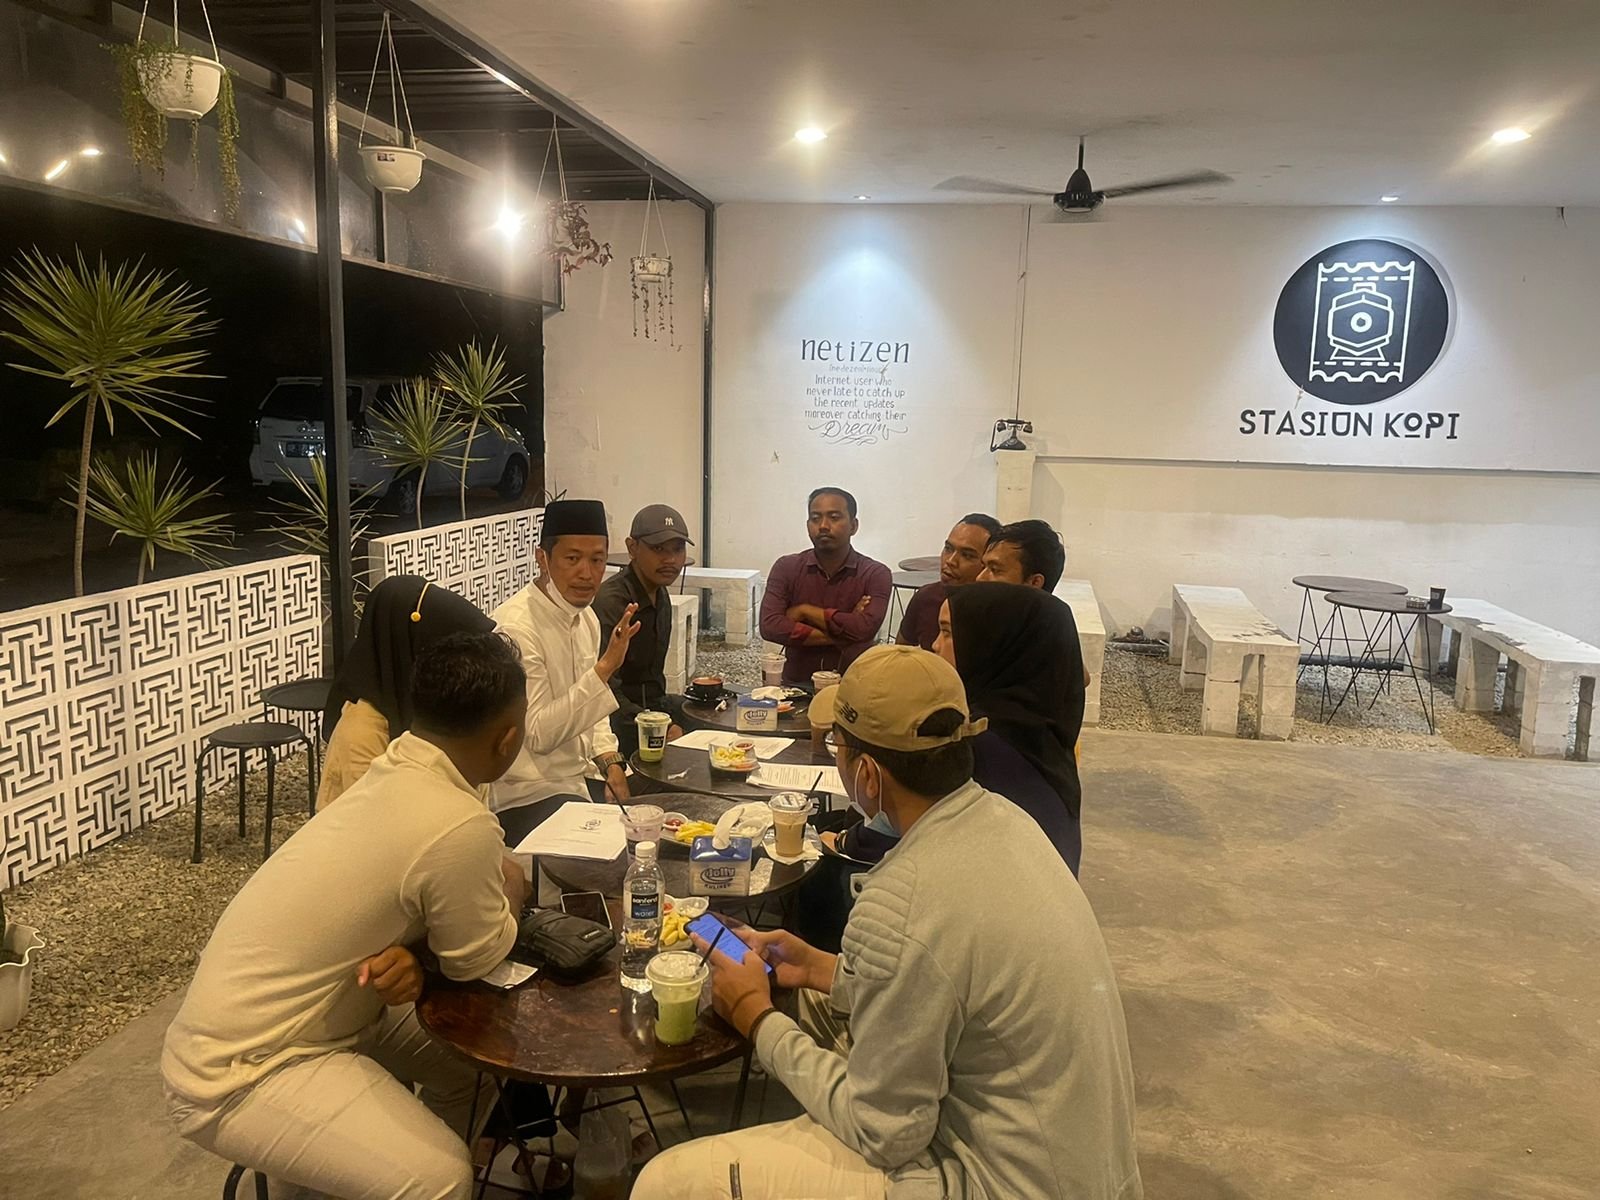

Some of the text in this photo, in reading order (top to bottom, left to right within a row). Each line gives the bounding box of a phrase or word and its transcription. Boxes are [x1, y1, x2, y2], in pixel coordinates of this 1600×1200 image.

[801, 339, 909, 363] netizen
[815, 374, 851, 385] Internet
[854, 377, 873, 386] user
[806, 386, 906, 399] never late to catch up
[814, 396, 895, 409] the recent updates
[804, 409, 907, 422] moreover catching their
[1239, 409, 1460, 440] STASIUN KOPI
